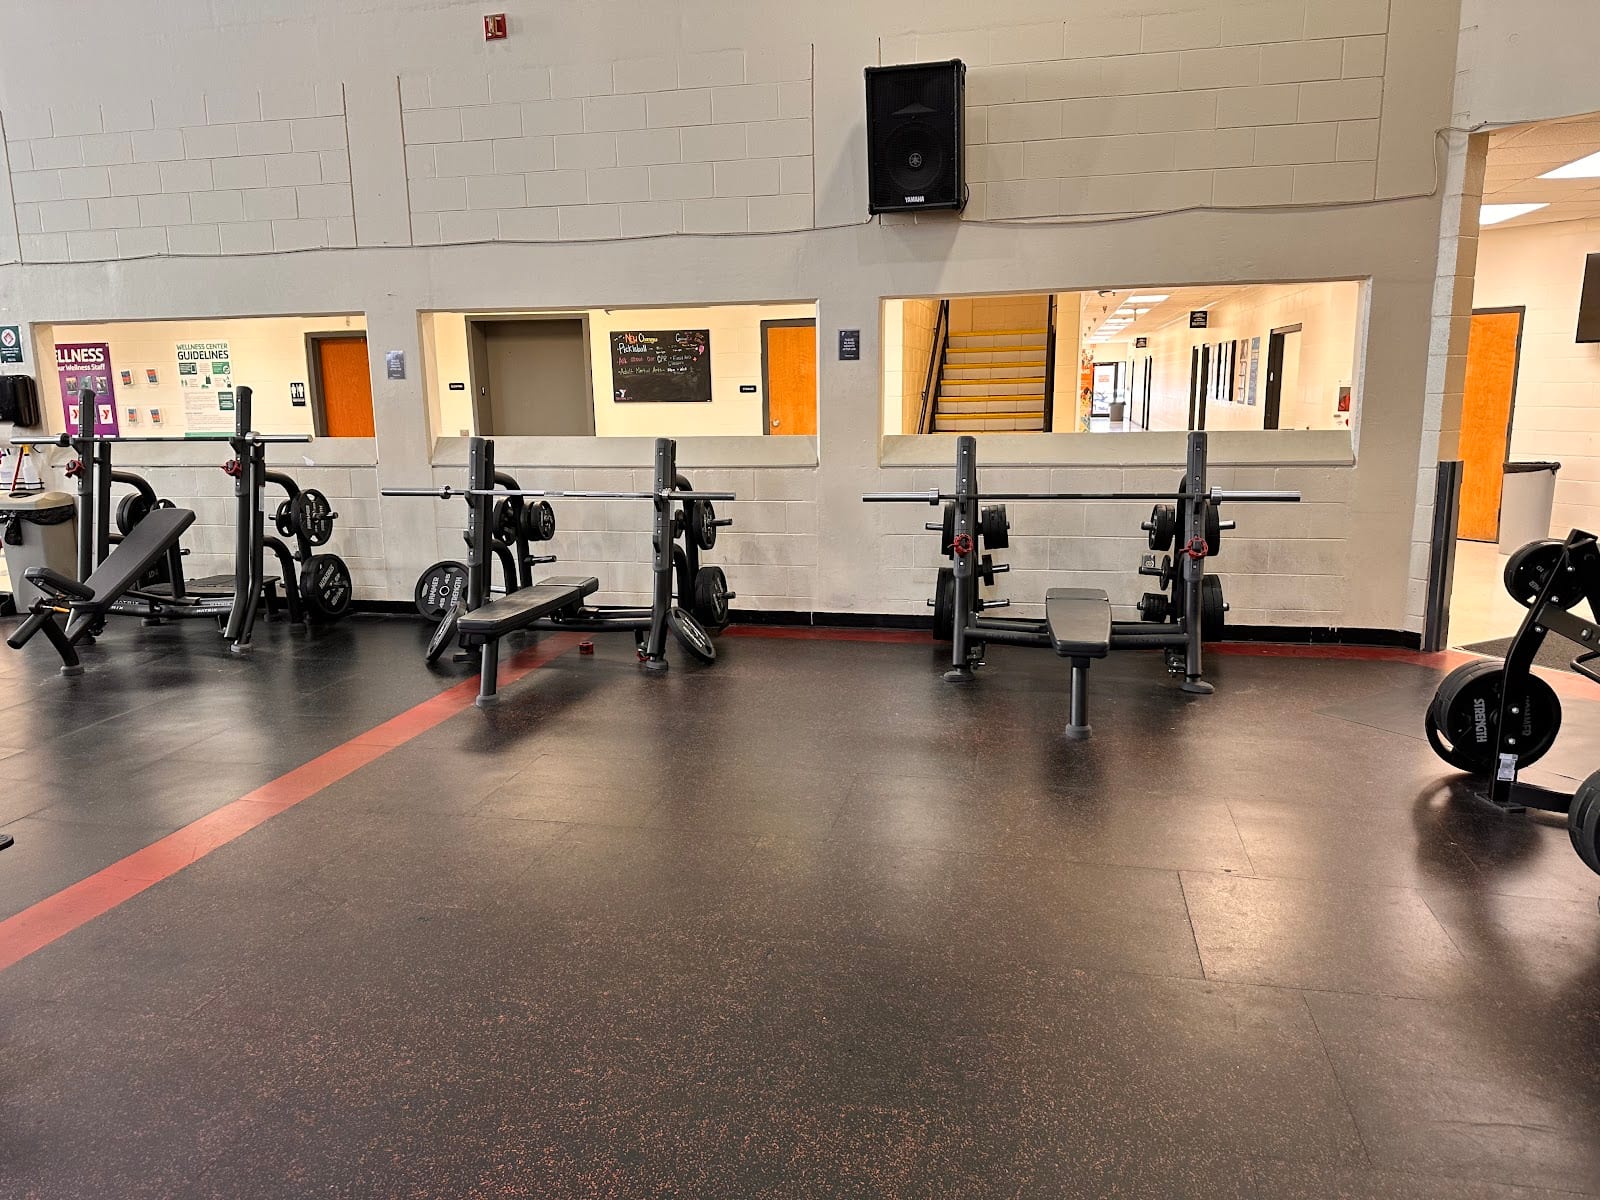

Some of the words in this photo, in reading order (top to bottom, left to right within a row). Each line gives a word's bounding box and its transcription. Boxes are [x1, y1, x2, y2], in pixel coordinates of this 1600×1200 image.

[177, 350, 229, 360] GUIDELINES
[427, 577, 440, 605] HAMMER
[1473, 698, 1488, 743] STRENGTH
